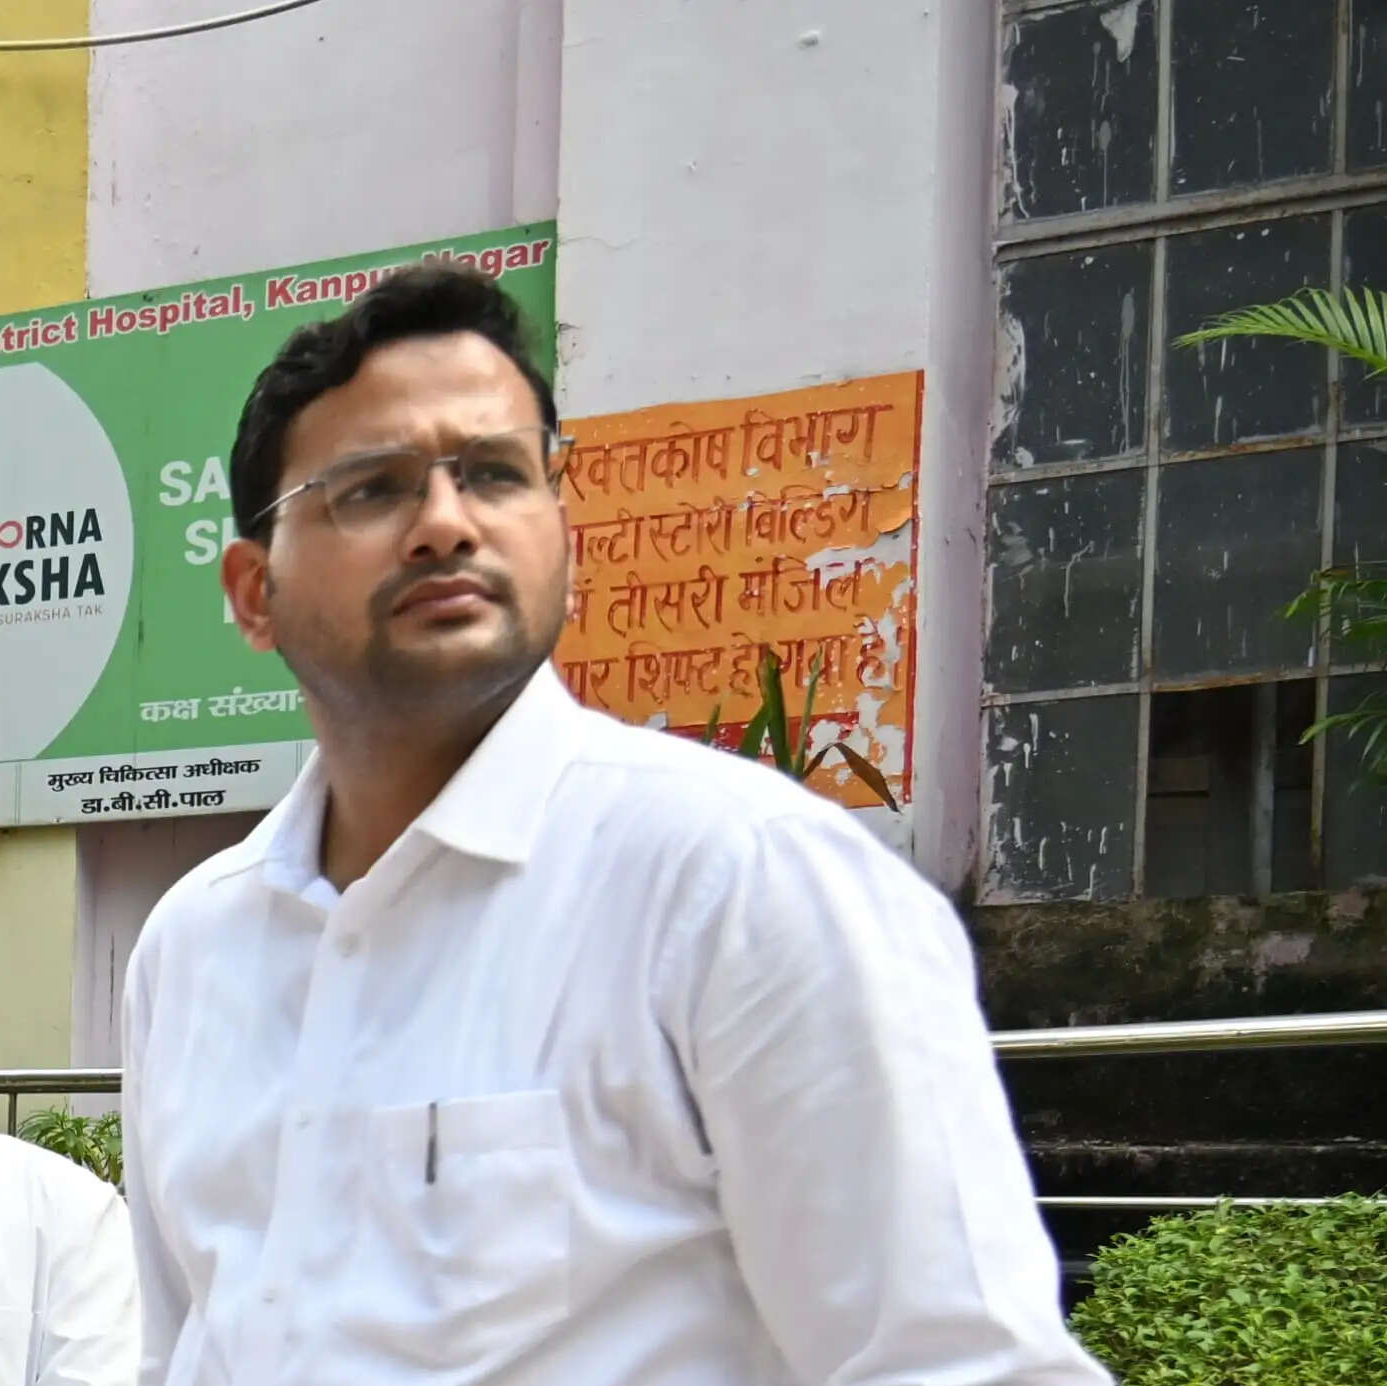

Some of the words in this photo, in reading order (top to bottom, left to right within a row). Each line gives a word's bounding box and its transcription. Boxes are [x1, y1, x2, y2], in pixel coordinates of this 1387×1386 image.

[87, 284, 255, 338] Hospital,
[265, 266, 405, 312] Kanp
[741, 405, 894, 476] विभाग
[649, 496, 737, 563] स्टोरी
[76, 604, 103, 618] TAK
[608, 565, 728, 638] तीसरी
[139, 699, 201, 722] कक्ष
[47, 770, 94, 792] मुख्य
[99, 765, 178, 784] चिकित्सा
[182, 758, 262, 779] अधीक्षक
